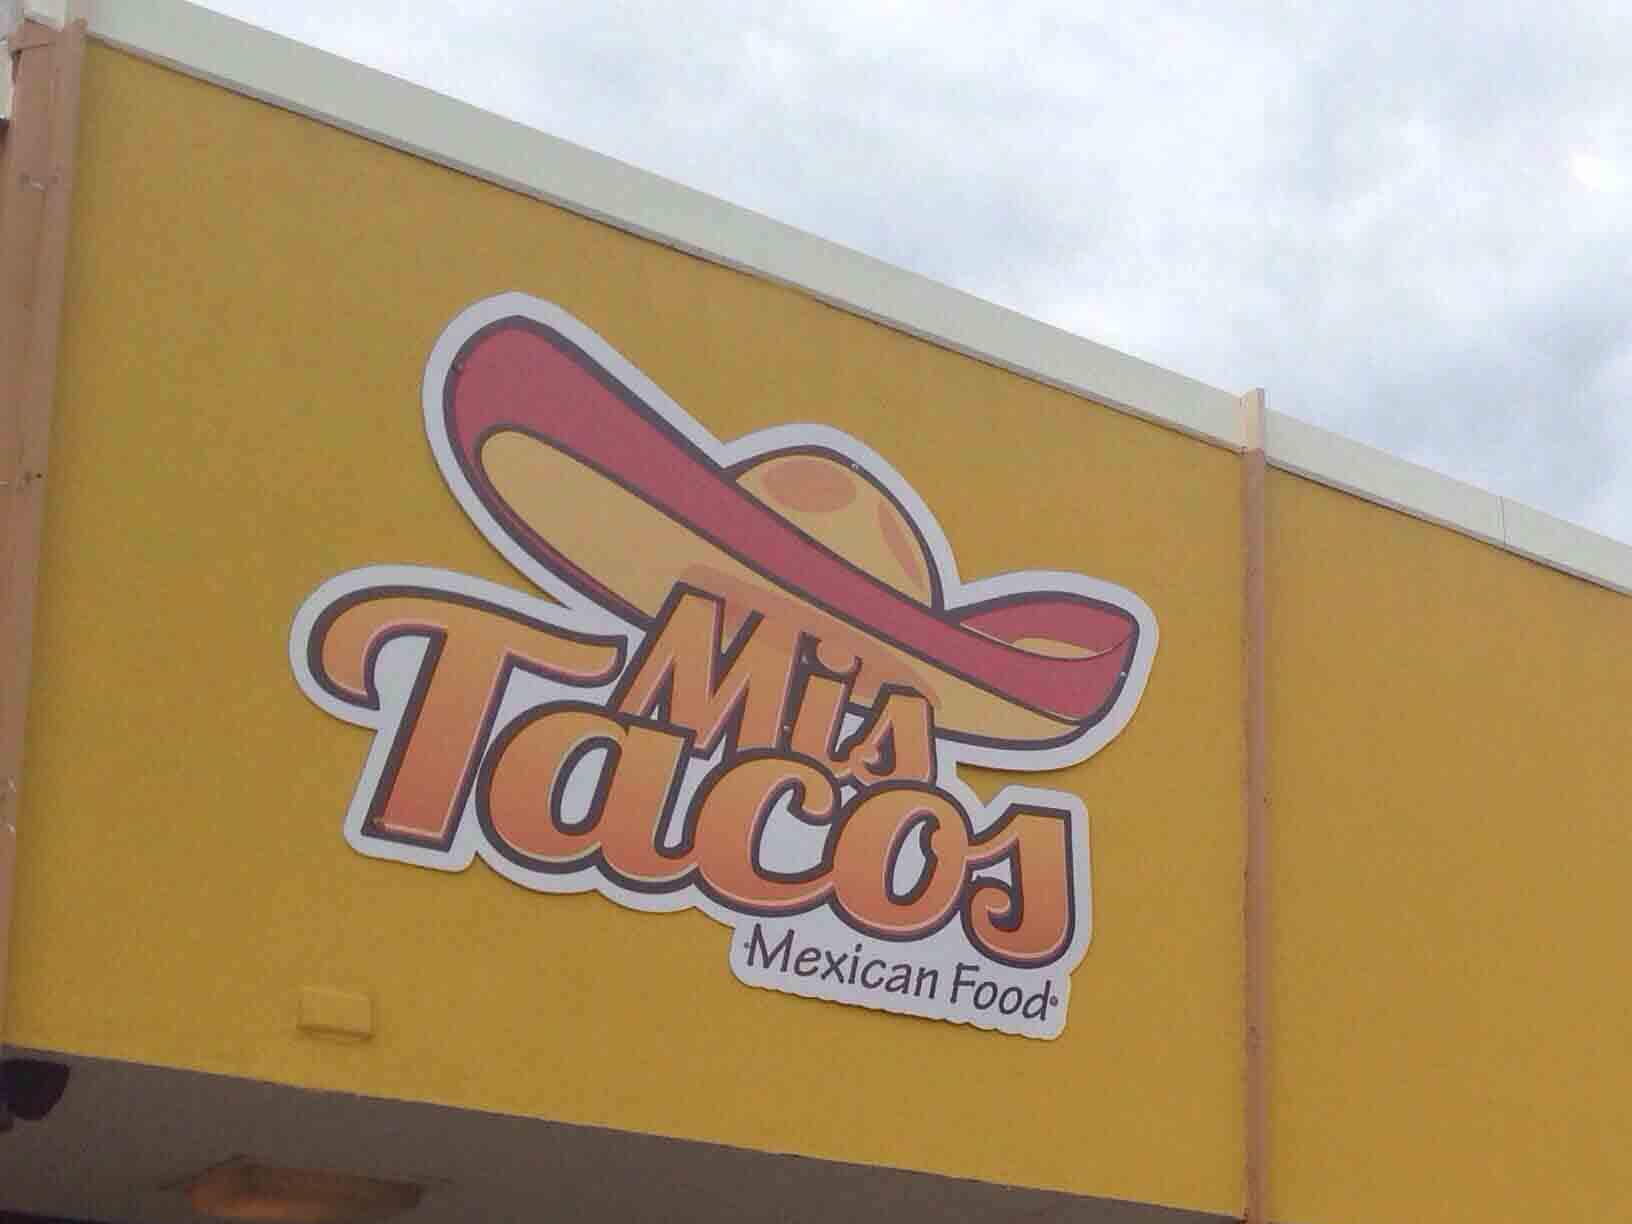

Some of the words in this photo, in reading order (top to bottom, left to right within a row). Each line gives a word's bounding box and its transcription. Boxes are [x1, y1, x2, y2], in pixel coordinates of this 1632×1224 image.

[307, 587, 1074, 968] Tacos
[608, 580, 938, 788] Mis
[746, 925, 939, 999] Mexican
[951, 962, 1051, 1021] Food
